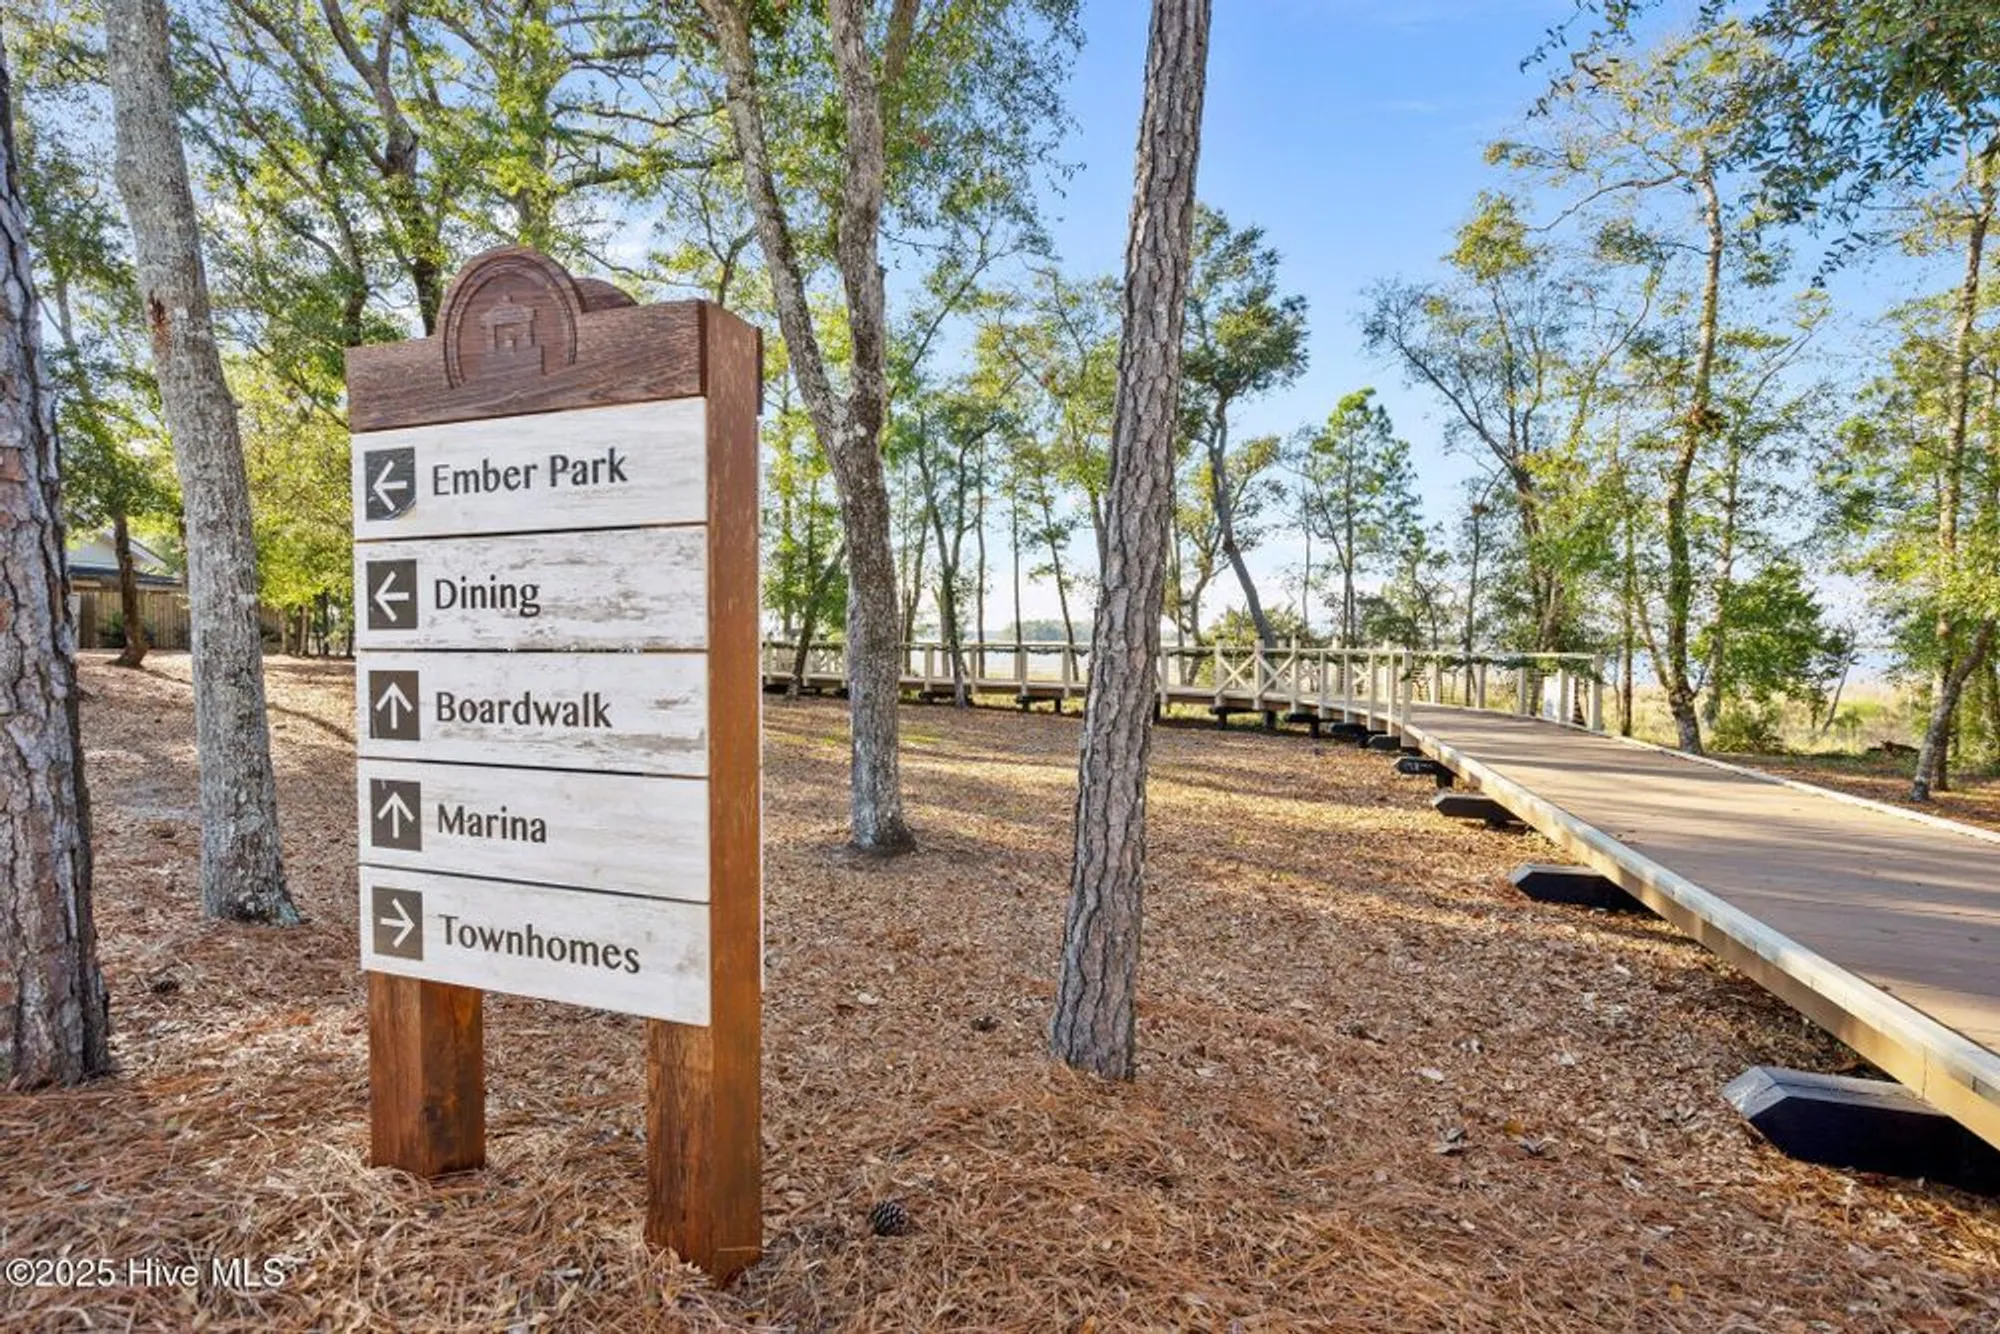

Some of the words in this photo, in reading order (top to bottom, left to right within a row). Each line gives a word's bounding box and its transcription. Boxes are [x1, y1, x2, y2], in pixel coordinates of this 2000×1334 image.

[432, 458, 539, 497] Ember
[549, 446, 629, 488] Park
[434, 574, 542, 619] Dining
[435, 691, 613, 728] Boardwalk
[437, 803, 547, 843] Marina
[438, 914, 641, 974] Townhomes
